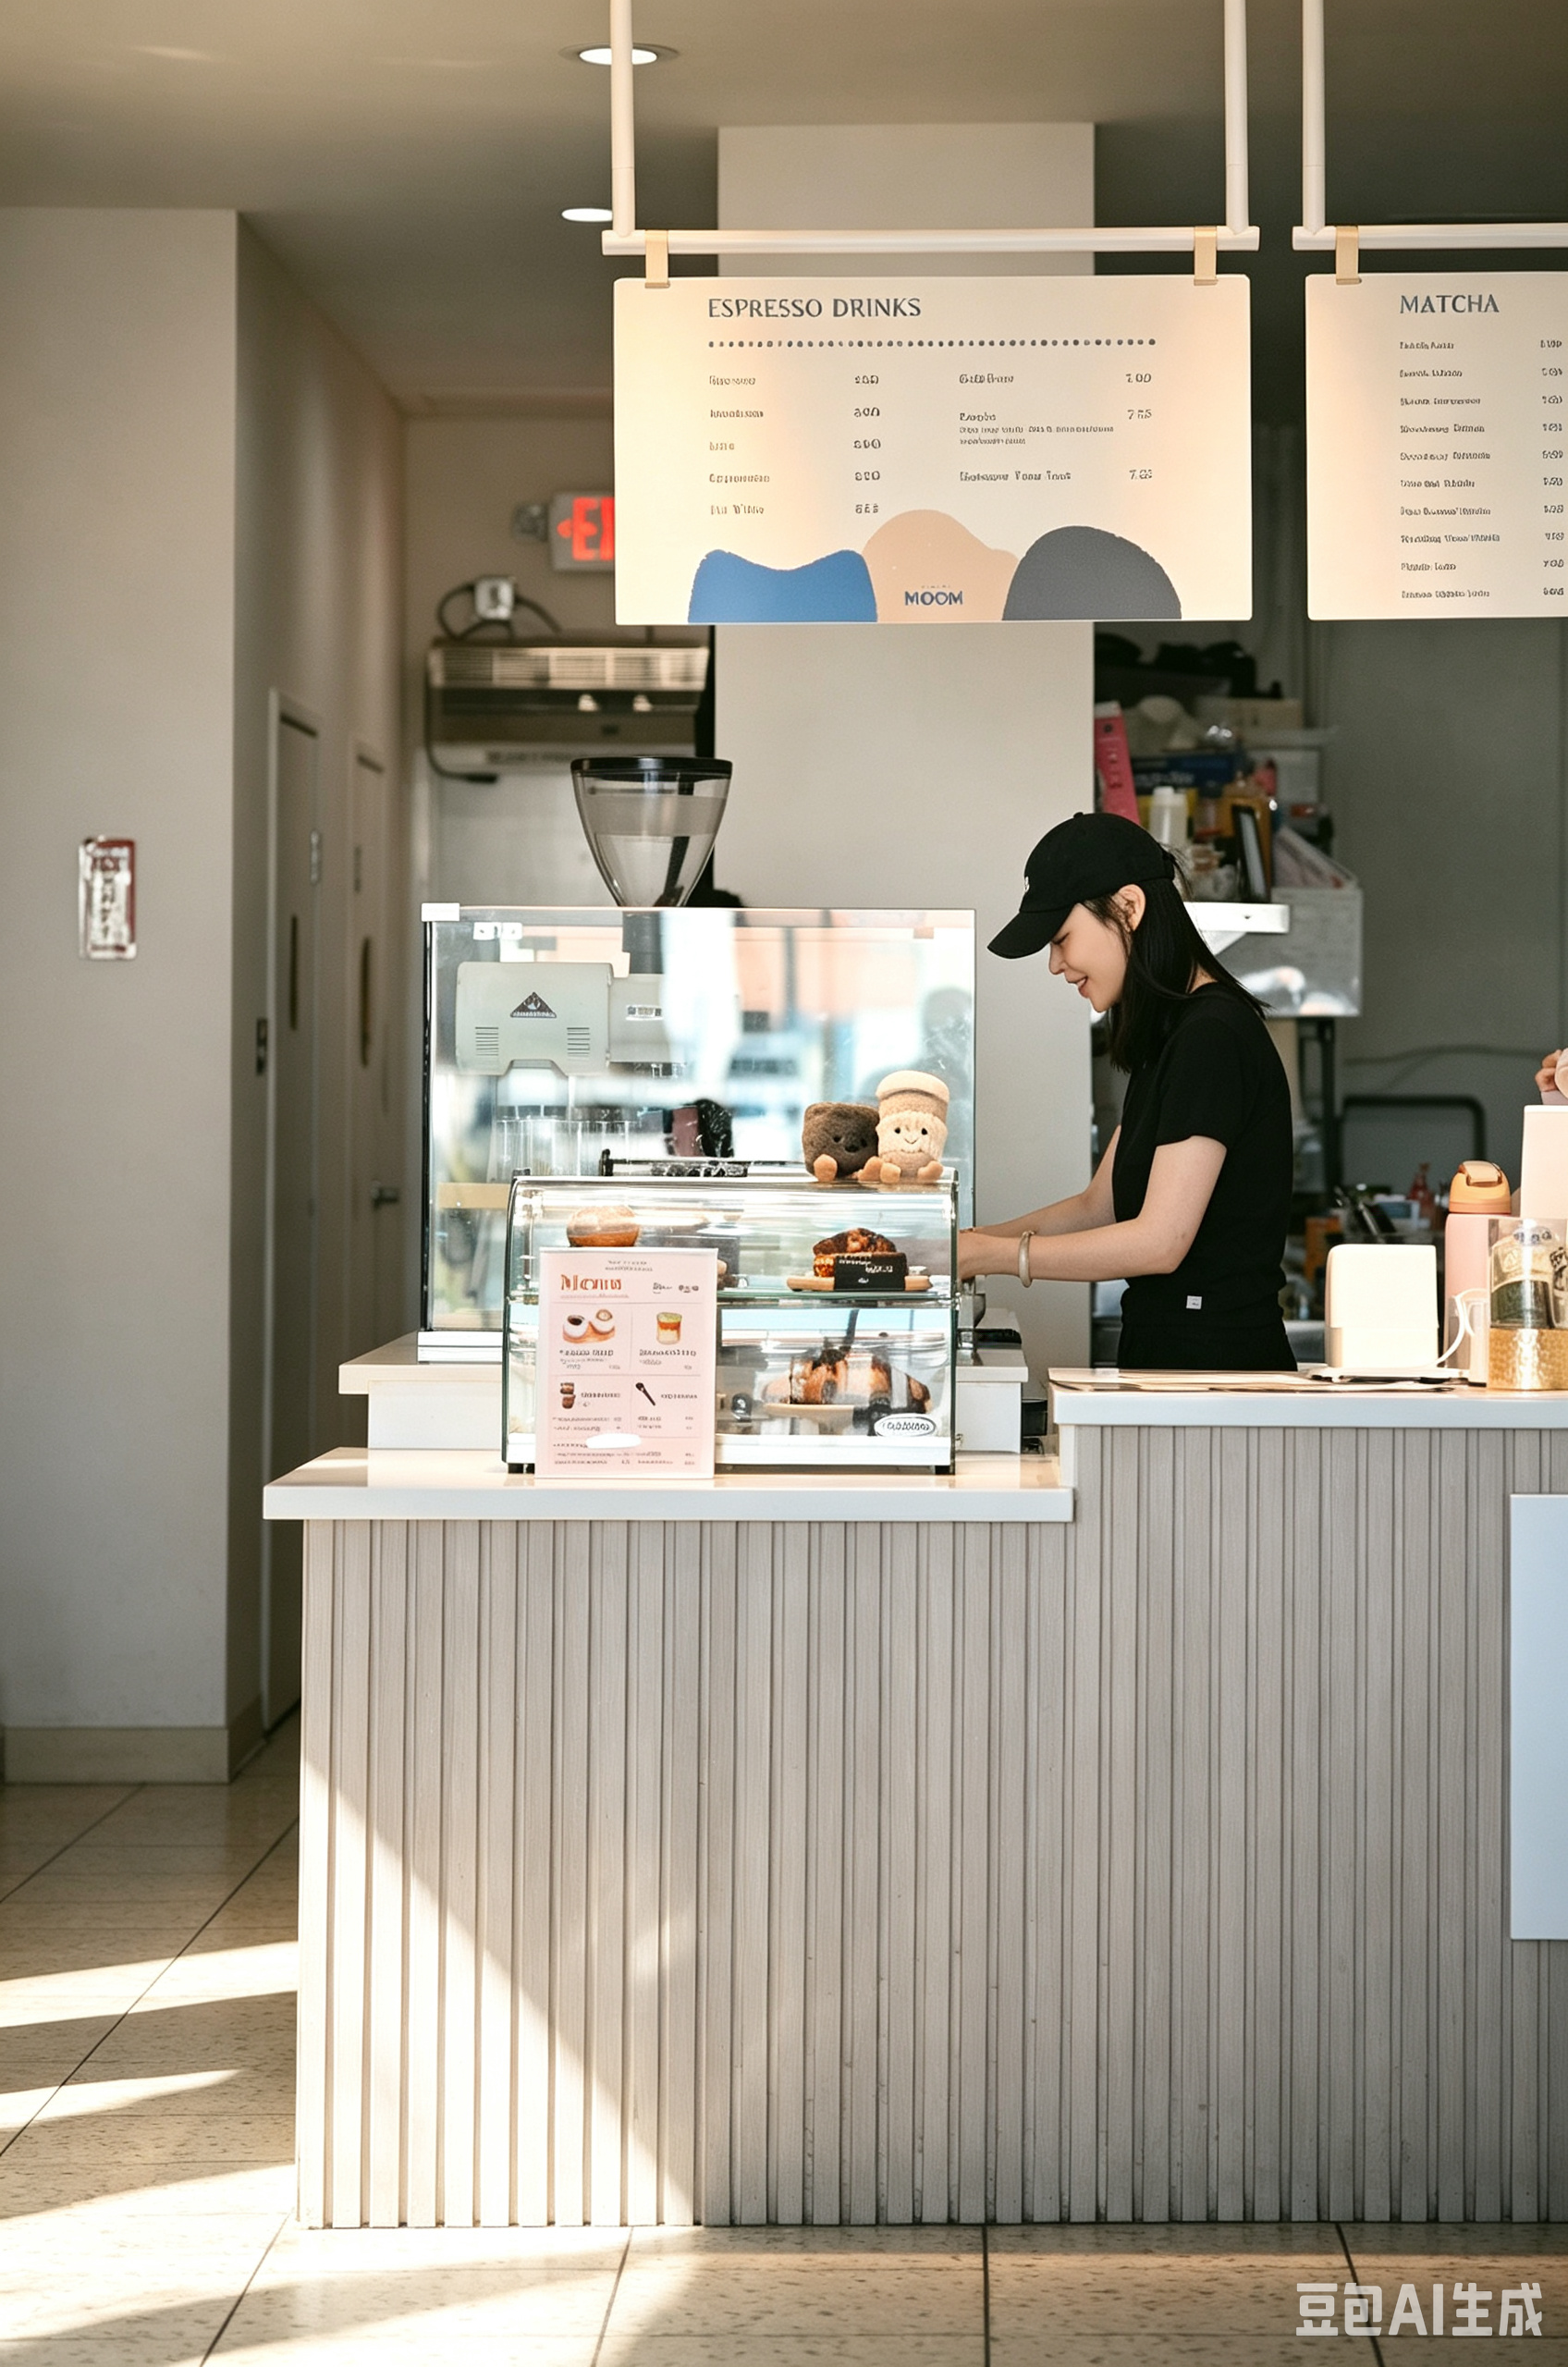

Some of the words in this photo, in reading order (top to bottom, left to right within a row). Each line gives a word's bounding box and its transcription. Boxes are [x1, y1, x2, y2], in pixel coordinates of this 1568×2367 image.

[708, 298, 823, 318] ESPRESSO
[832, 297, 922, 318] DRINKS
[1399, 294, 1500, 314] MATCHA
[904, 591, 963, 607] MOOM
